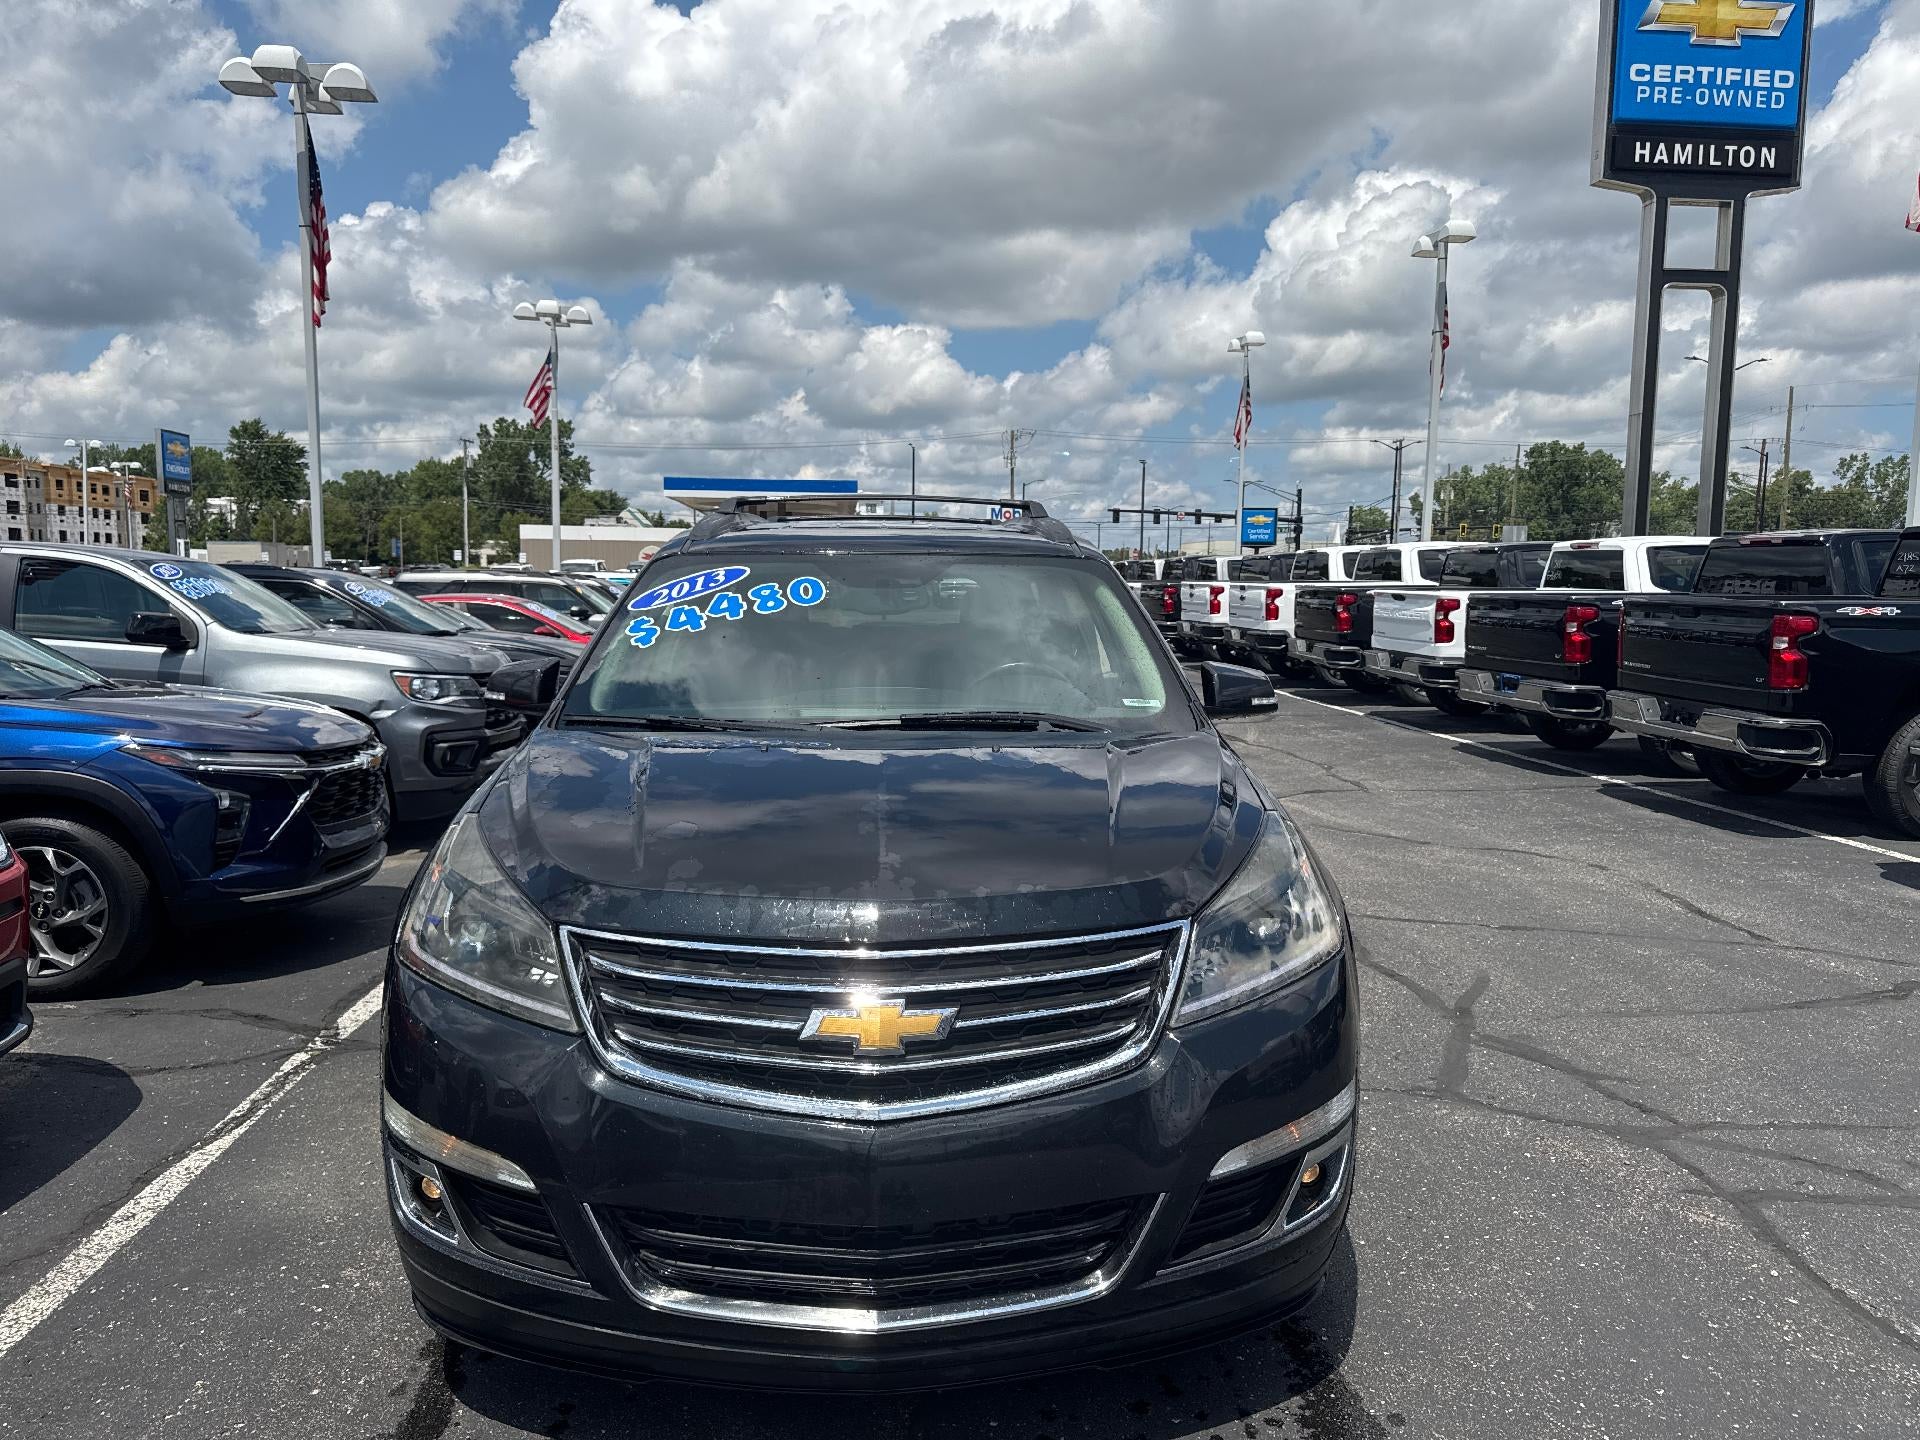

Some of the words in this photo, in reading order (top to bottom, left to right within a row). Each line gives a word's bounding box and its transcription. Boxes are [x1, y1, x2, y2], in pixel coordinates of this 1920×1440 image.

[1629, 63, 1795, 89] CERTIFIED
[1636, 85, 1785, 109] PRE-OWNED
[1634, 141, 1776, 169] HAMILTON
[652, 570, 727, 606] 2013
[625, 576, 827, 648] $4480
